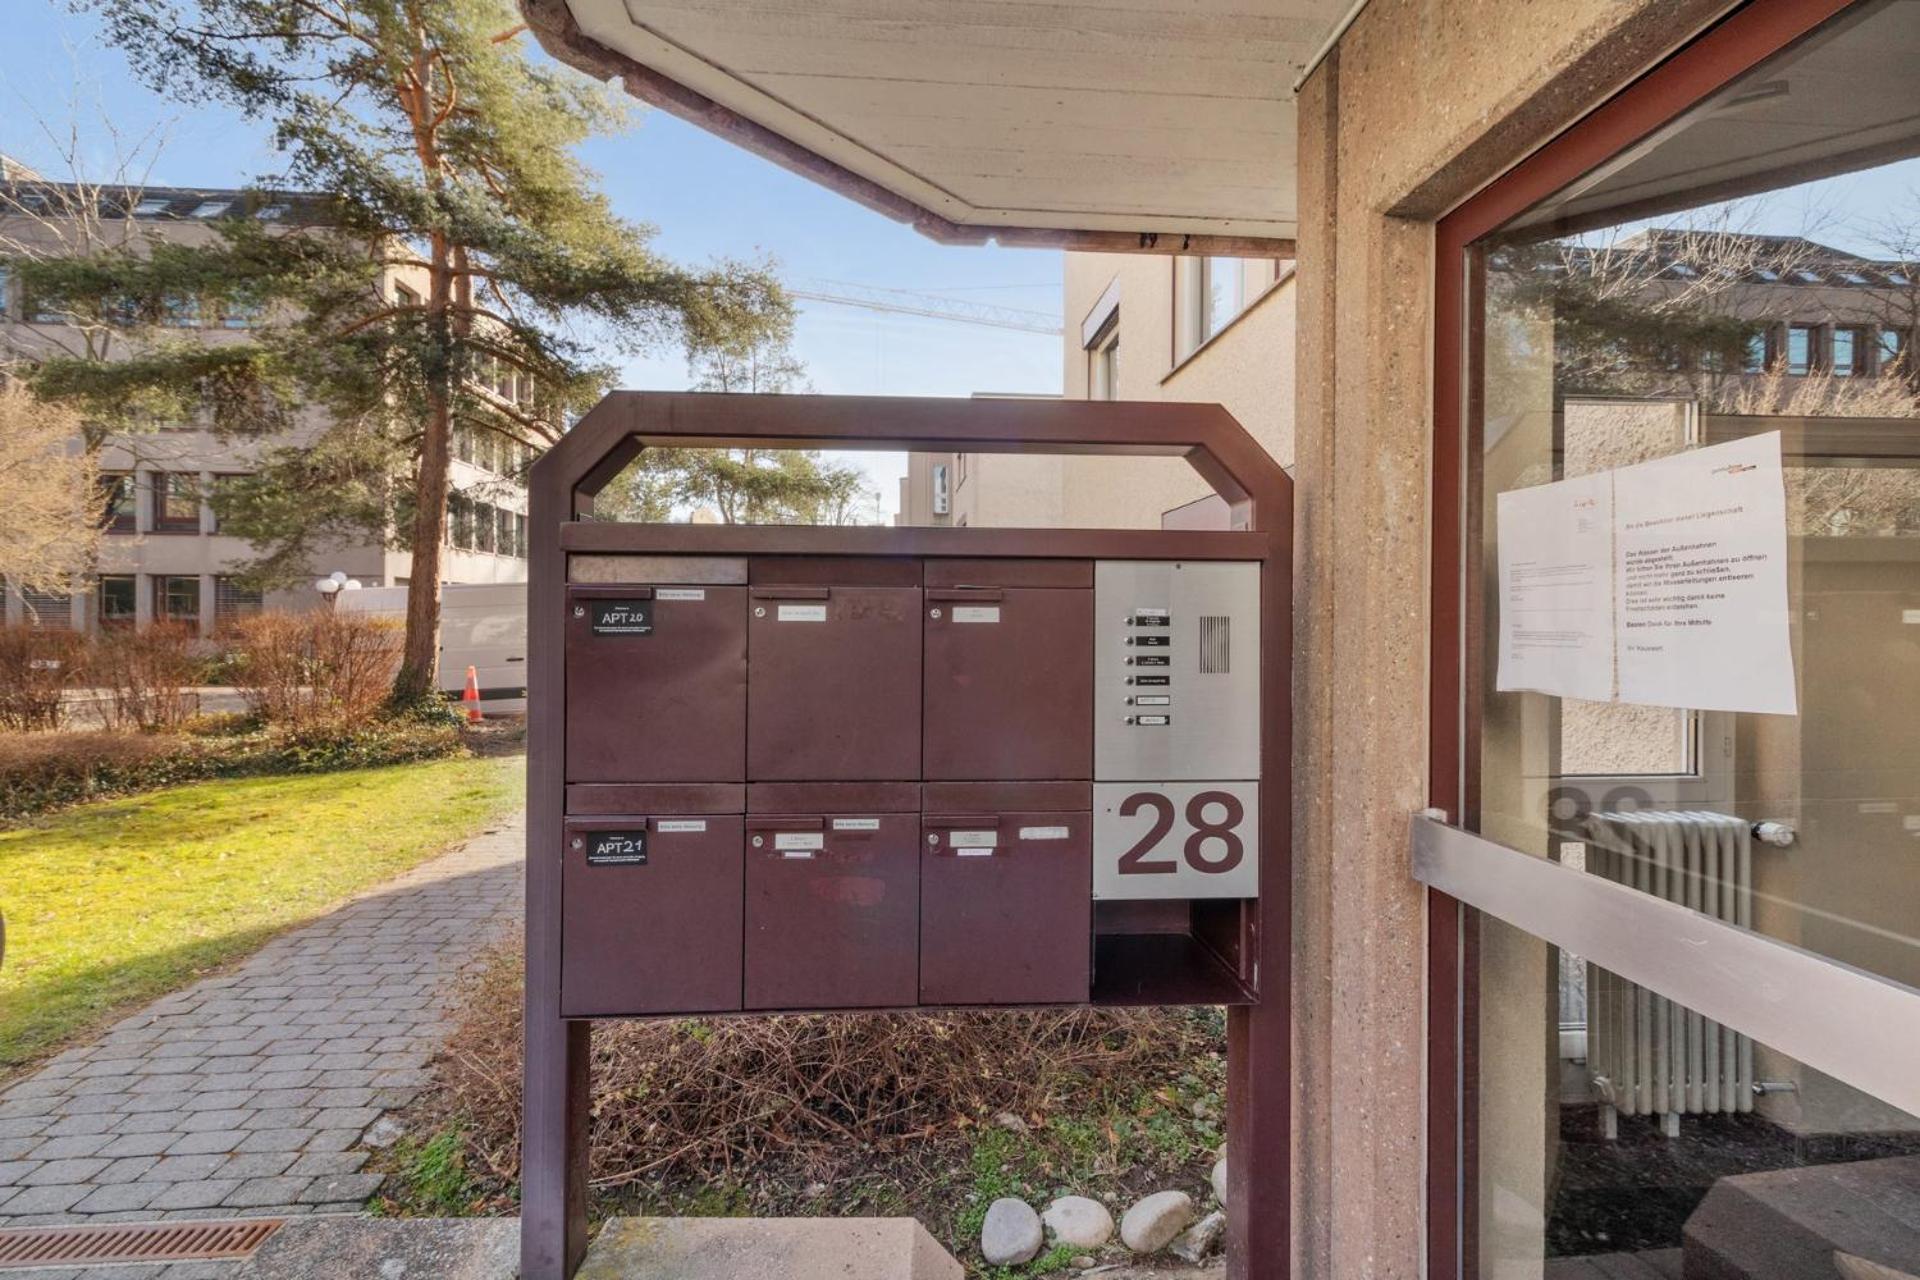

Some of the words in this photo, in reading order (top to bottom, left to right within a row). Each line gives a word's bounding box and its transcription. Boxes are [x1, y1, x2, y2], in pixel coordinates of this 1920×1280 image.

[602, 613, 628, 624] APT
[629, 613, 643, 622] 20
[1119, 791, 1243, 875] 28
[597, 842, 623, 853] APT
[623, 839, 642, 852] 21
